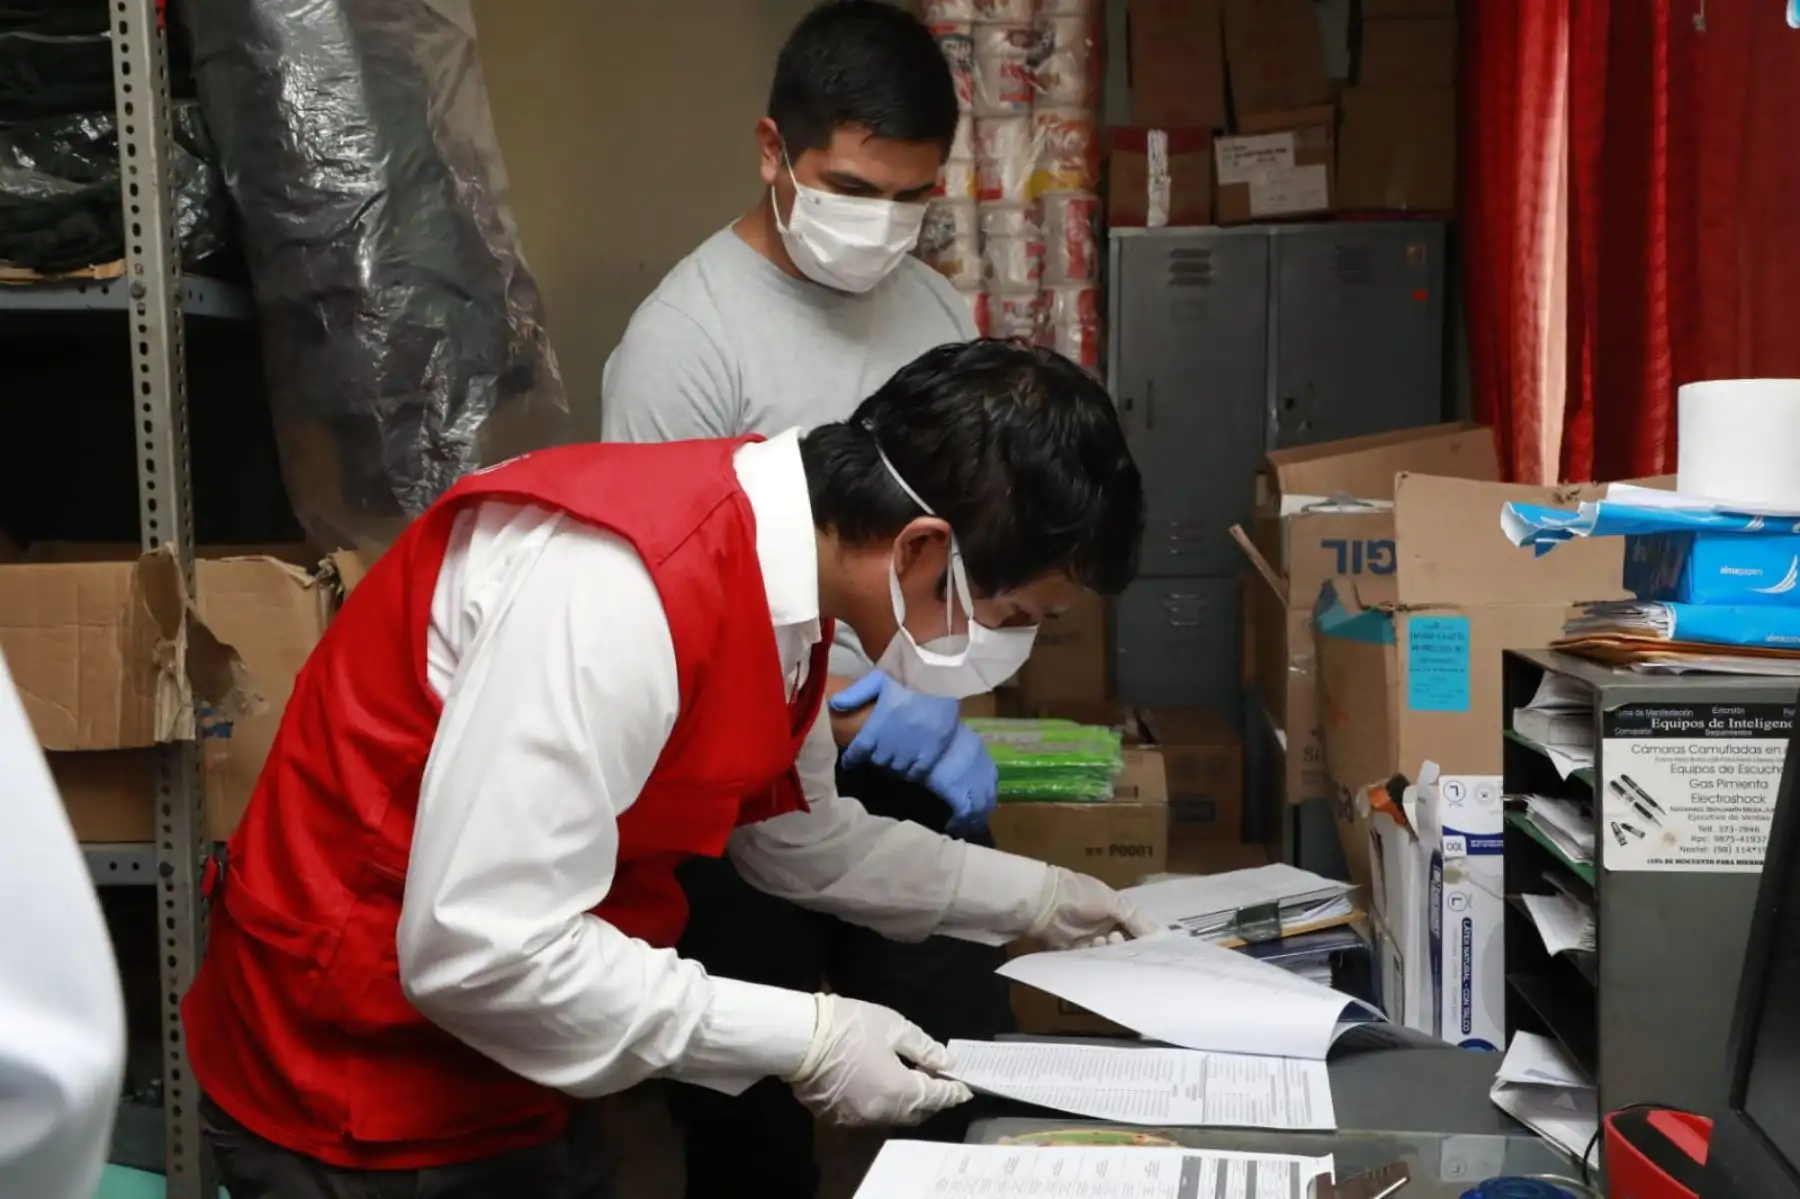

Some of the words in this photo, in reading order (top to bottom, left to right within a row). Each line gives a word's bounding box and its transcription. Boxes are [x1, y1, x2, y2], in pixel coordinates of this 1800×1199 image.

[1651, 718, 1704, 731] Equipos
[1708, 718, 1724, 728] de
[1631, 743, 1685, 755] Cámaras
[1688, 744, 1762, 756] Camufladas
[1765, 746, 1781, 755] en
[1670, 764, 1715, 775] Equipos
[1718, 764, 1734, 775] de
[1689, 779, 1714, 789] Gas
[1717, 779, 1769, 790] Pimienta
[1691, 793, 1766, 804] Electroshock
